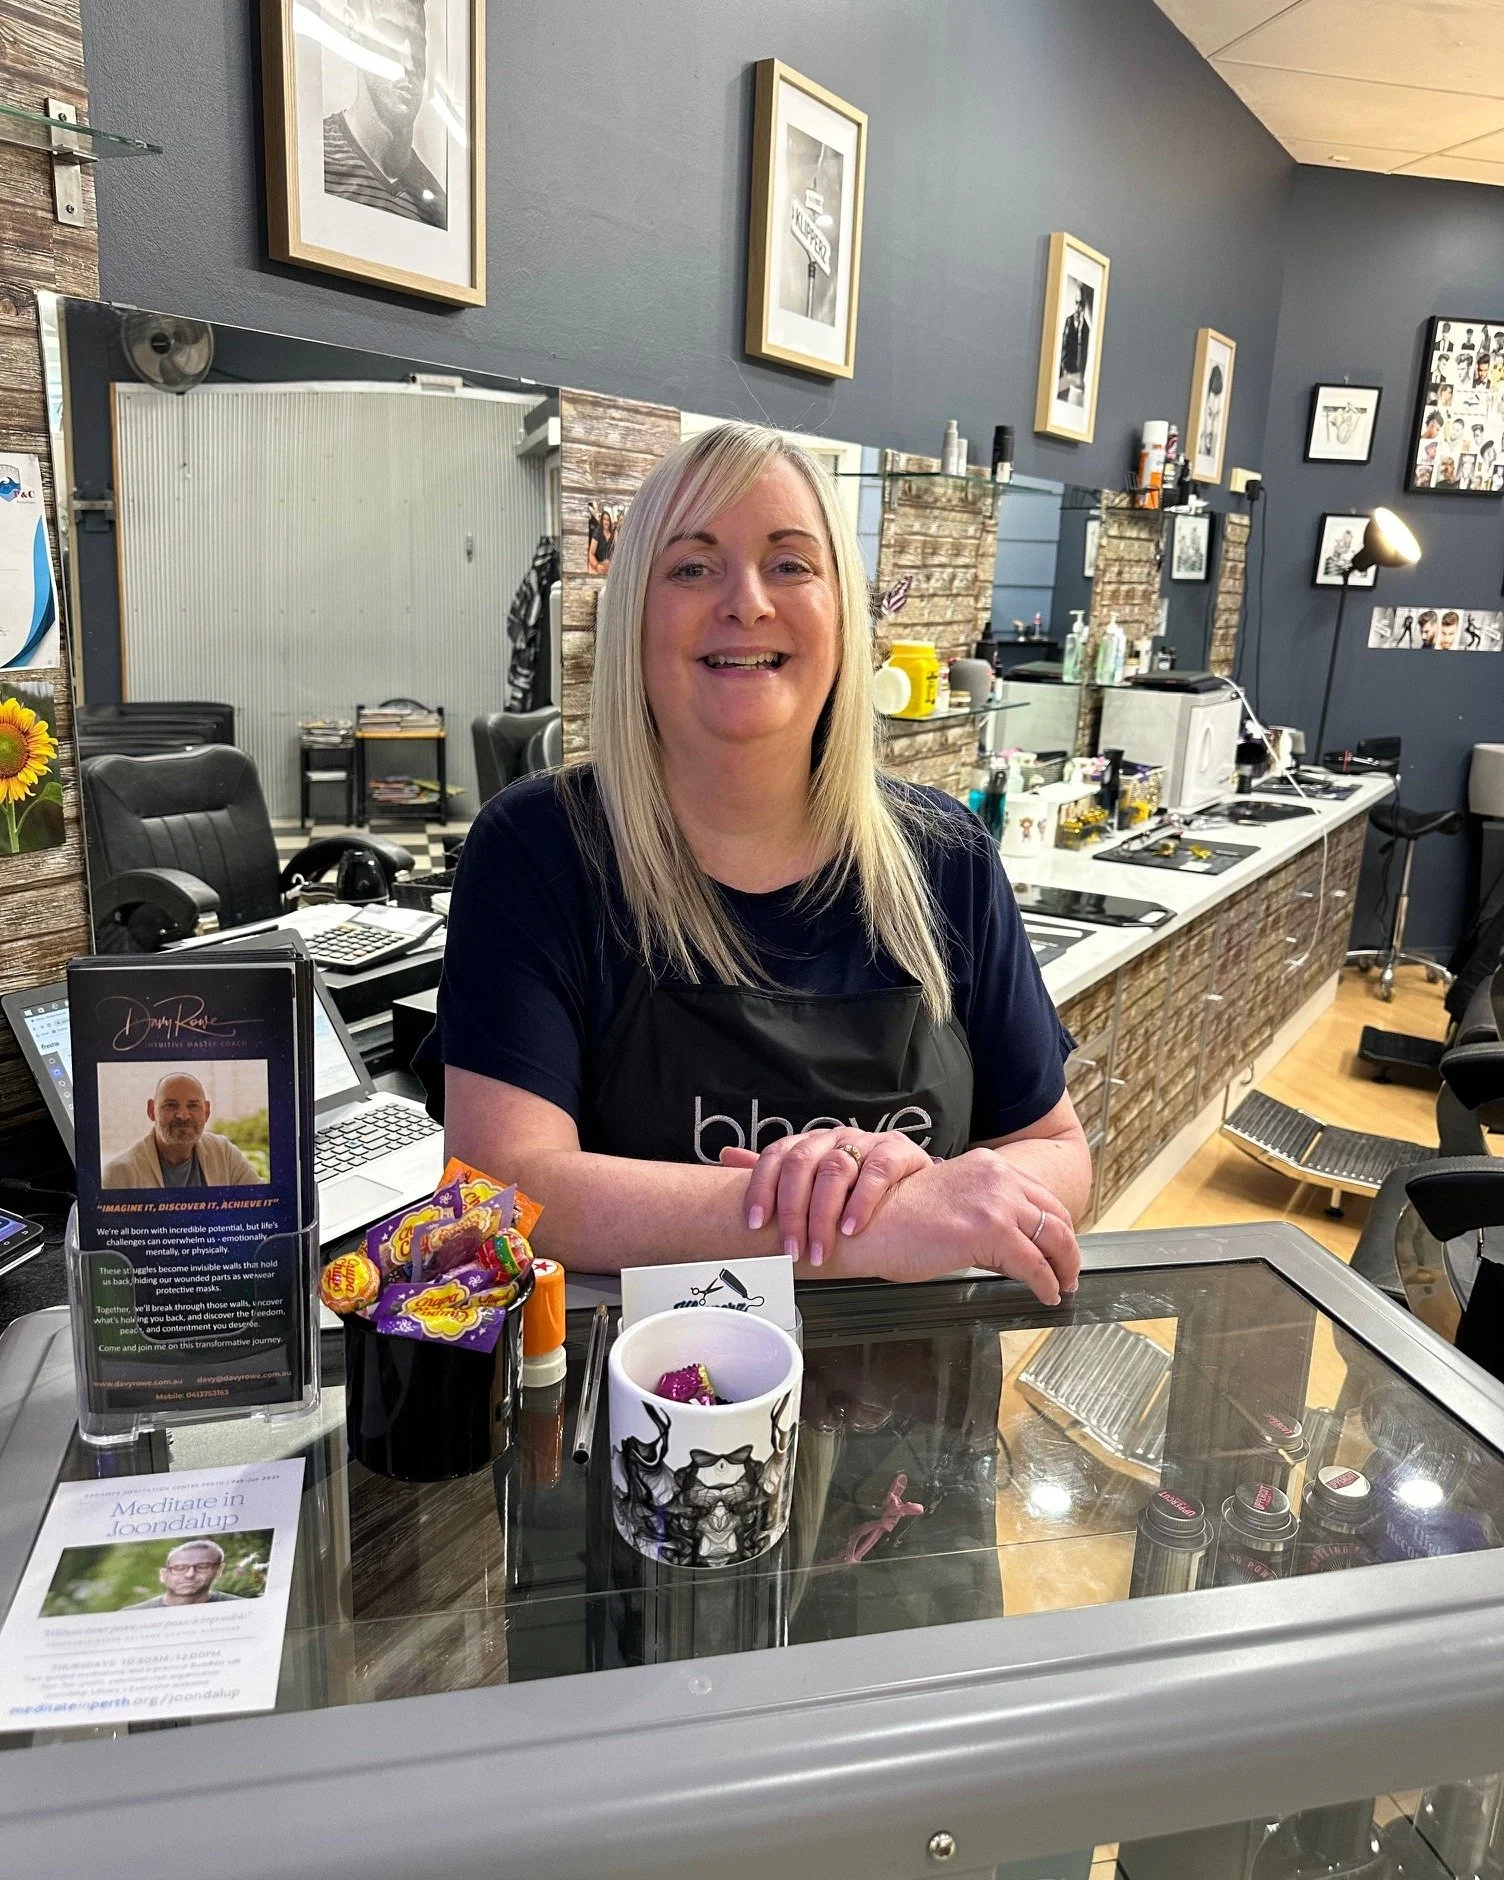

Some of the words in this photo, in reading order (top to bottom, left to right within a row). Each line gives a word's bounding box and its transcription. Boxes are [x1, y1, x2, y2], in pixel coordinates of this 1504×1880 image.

[146, 1039, 183, 1049] INTUITIVE
[187, 1039, 216, 1049] MASTER
[219, 1038, 248, 1048] COACH
[144, 1203, 156, 1212] IT,
[158, 1201, 205, 1211] DISCOVER
[207, 1201, 219, 1210] IT,
[220, 1198, 261, 1208] ACHIEVE
[120, 1227, 129, 1235] all
[131, 1226, 148, 1235] born
[150, 1226, 167, 1234] with
[169, 1224, 206, 1233] incredible
[208, 1223, 243, 1233] potential,
[245, 1222, 259, 1230] but
[106, 1236, 145, 1247] challenges
[162, 1235, 204, 1244] overwhelm
[145, 1247, 179, 1257] mentally,
[191, 1244, 229, 1255] physically.
[99, 1266, 121, 1274] These
[123, 1264, 156, 1275] stuggles
[158, 1264, 188, 1272] become
[190, 1262, 220, 1270] invisible
[222, 1261, 241, 1270] walls
[243, 1260, 258, 1268] that
[260, 1259, 277, 1267] hold
[113, 1276, 132, 1286] back,
[134, 1276, 157, 1285] hiding
[174, 1274, 209, 1282] wounded
[211, 1273, 230, 1283] parts
[155, 1285, 194, 1295] protective
[195, 1283, 221, 1291] masks.
[95, 1304, 130, 1315] Together,
[152, 1303, 172, 1312] break
[174, 1301, 205, 1312] through
[206, 1300, 227, 1308] those
[229, 1299, 250, 1308] walls,
[166, 1313, 185, 1322] back,
[187, 1312, 201, 1320] and
[203, 1310, 234, 1319] discover
[236, 1309, 249, 1318] the
[251, 1307, 285, 1317] feedom,
[146, 1325, 160, 1333] and
[162, 1323, 210, 1332] contentment
[213, 1323, 226, 1331] you
[98, 1343, 120, 1352] Come
[122, 1343, 136, 1351] and
[138, 1342, 152, 1352] join
[180, 1340, 194, 1348] this
[195, 1337, 250, 1347] transformative
[252, 1335, 282, 1345] journey.
[197, 1369, 291, 1383] davy@davyrowe.com.au
[155, 1391, 185, 1399] Mobile:
[111, 1492, 217, 1518] Meditate
[223, 1491, 245, 1507] in
[1157, 1490, 1196, 1518] UPPERCUT
[107, 1511, 239, 1538] Joondalup
[52, 1659, 115, 1671] THURSDAYS
